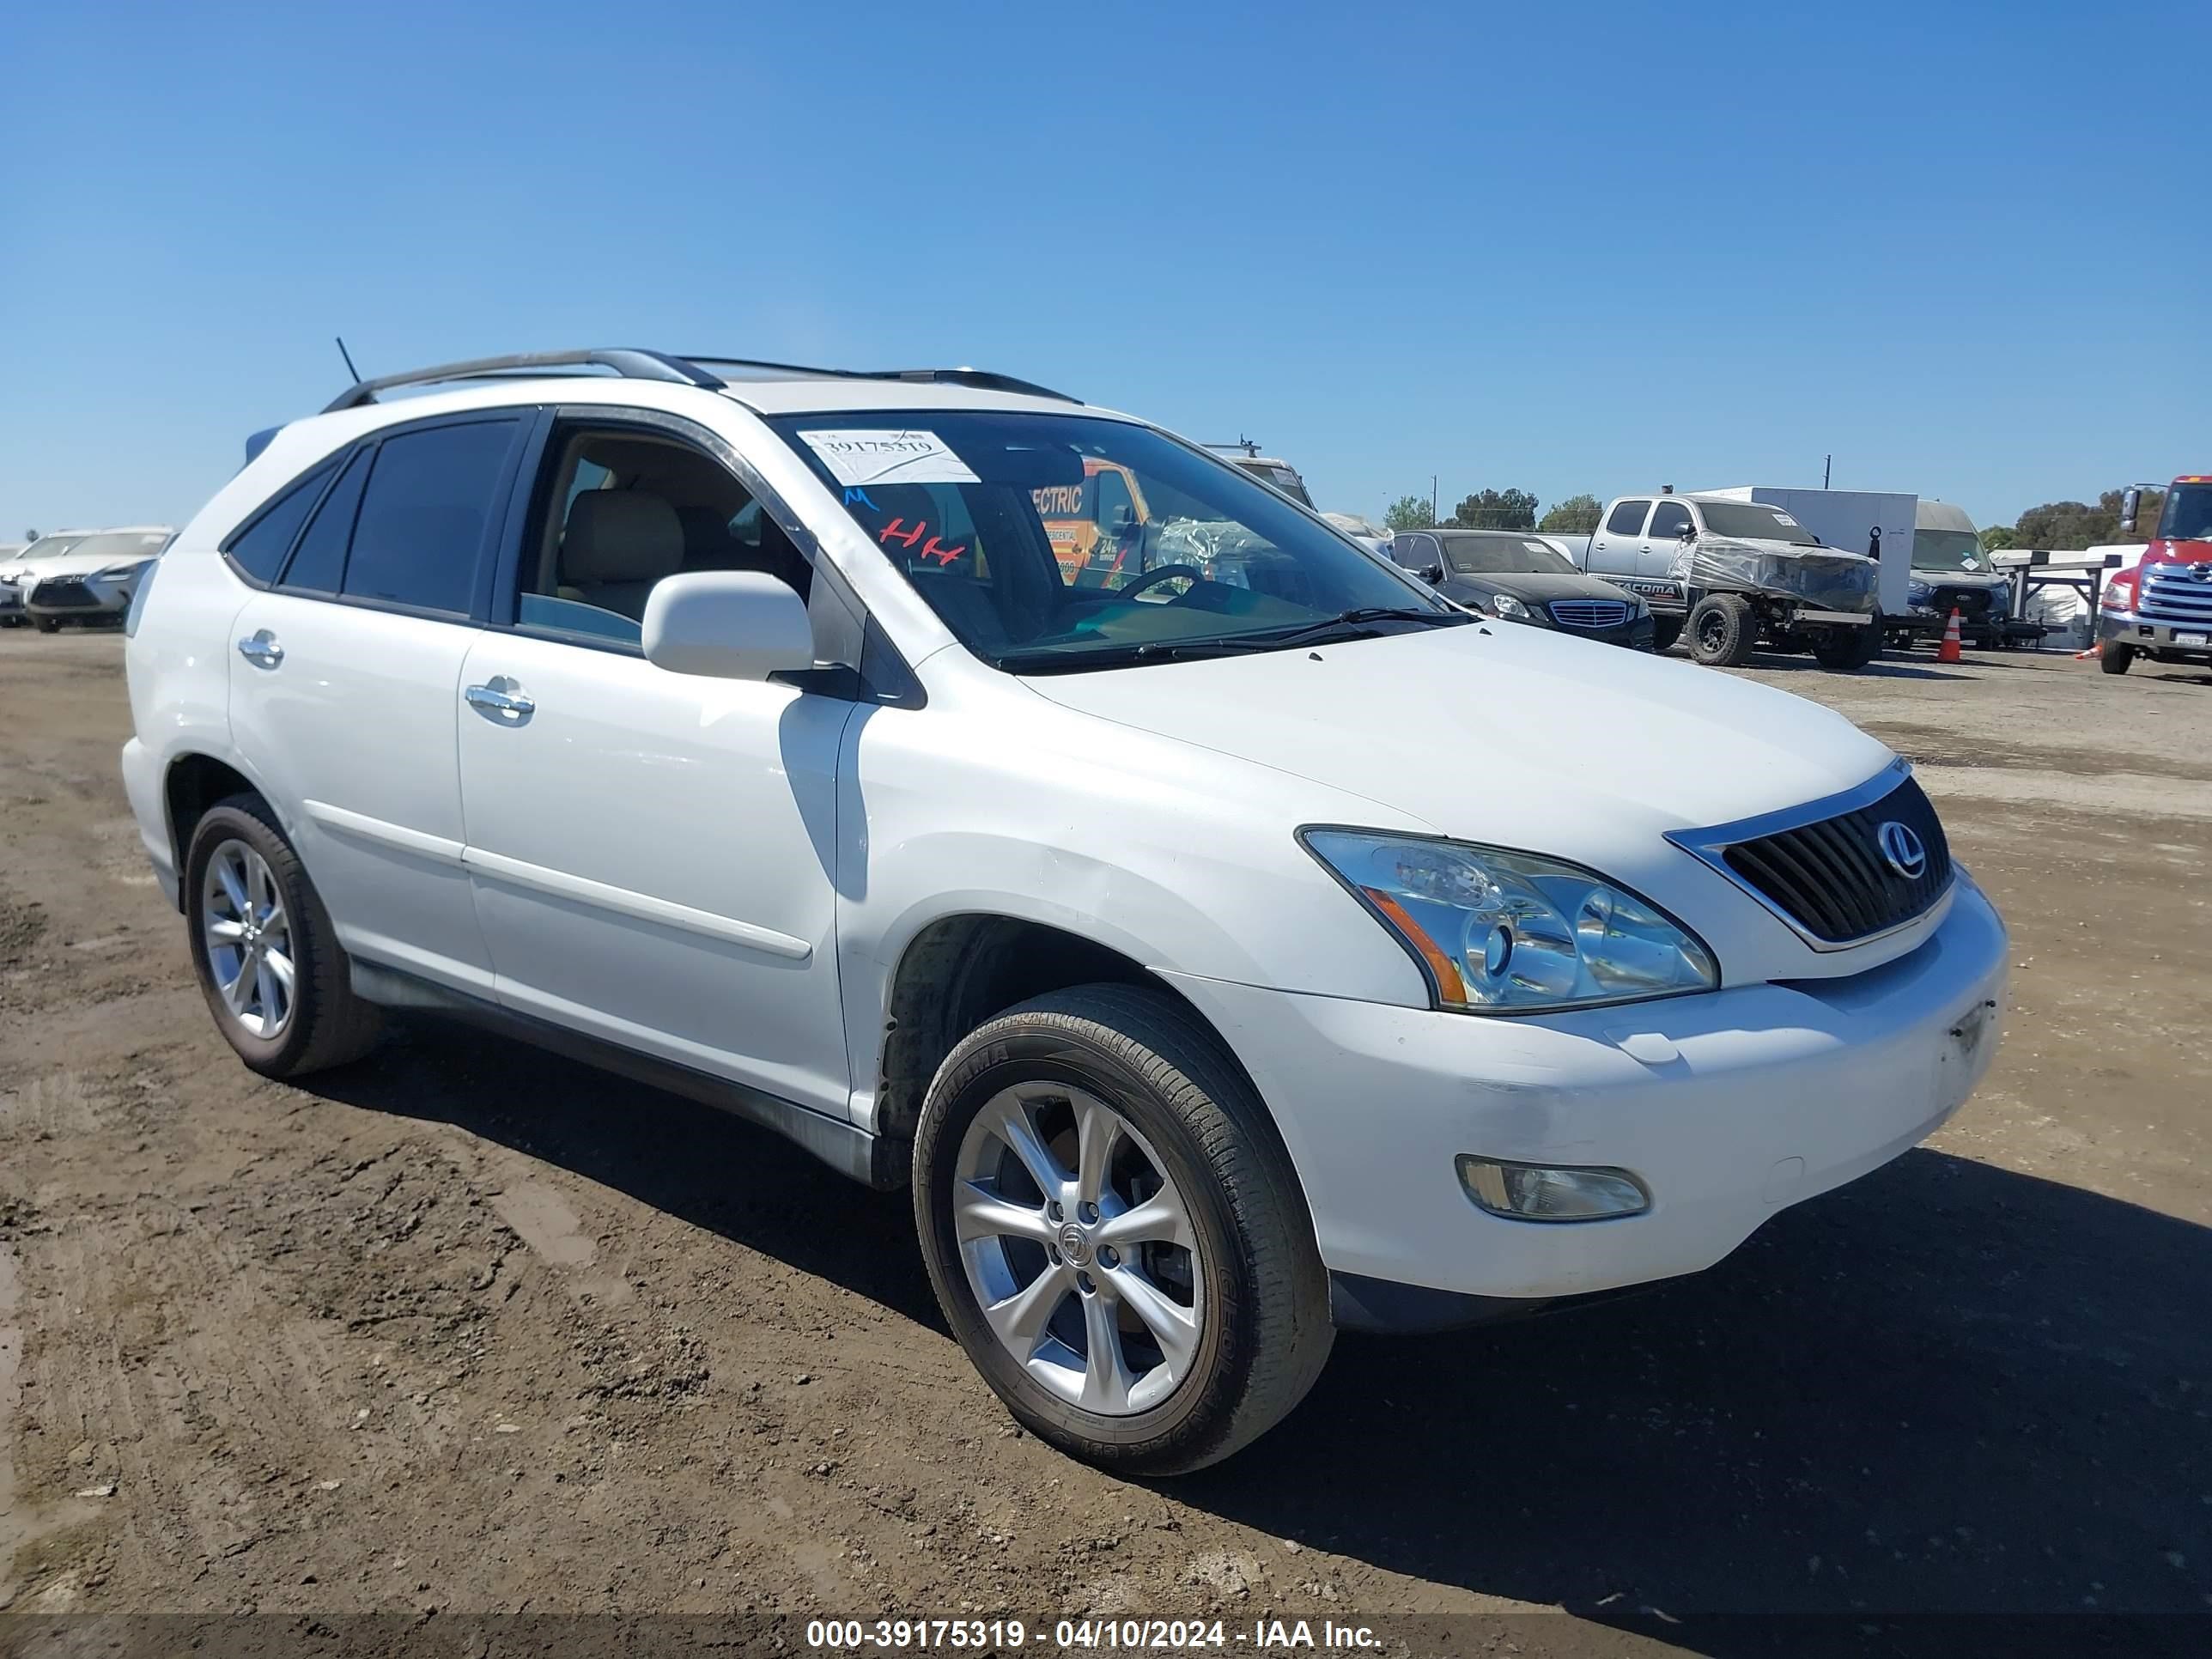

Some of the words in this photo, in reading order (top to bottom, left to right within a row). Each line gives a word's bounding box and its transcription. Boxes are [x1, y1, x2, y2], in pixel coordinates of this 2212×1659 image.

[824, 441, 933, 453] 39175319
[1030, 487, 1082, 514] ECTRIC
[1614, 582, 1675, 594] TACOMA
